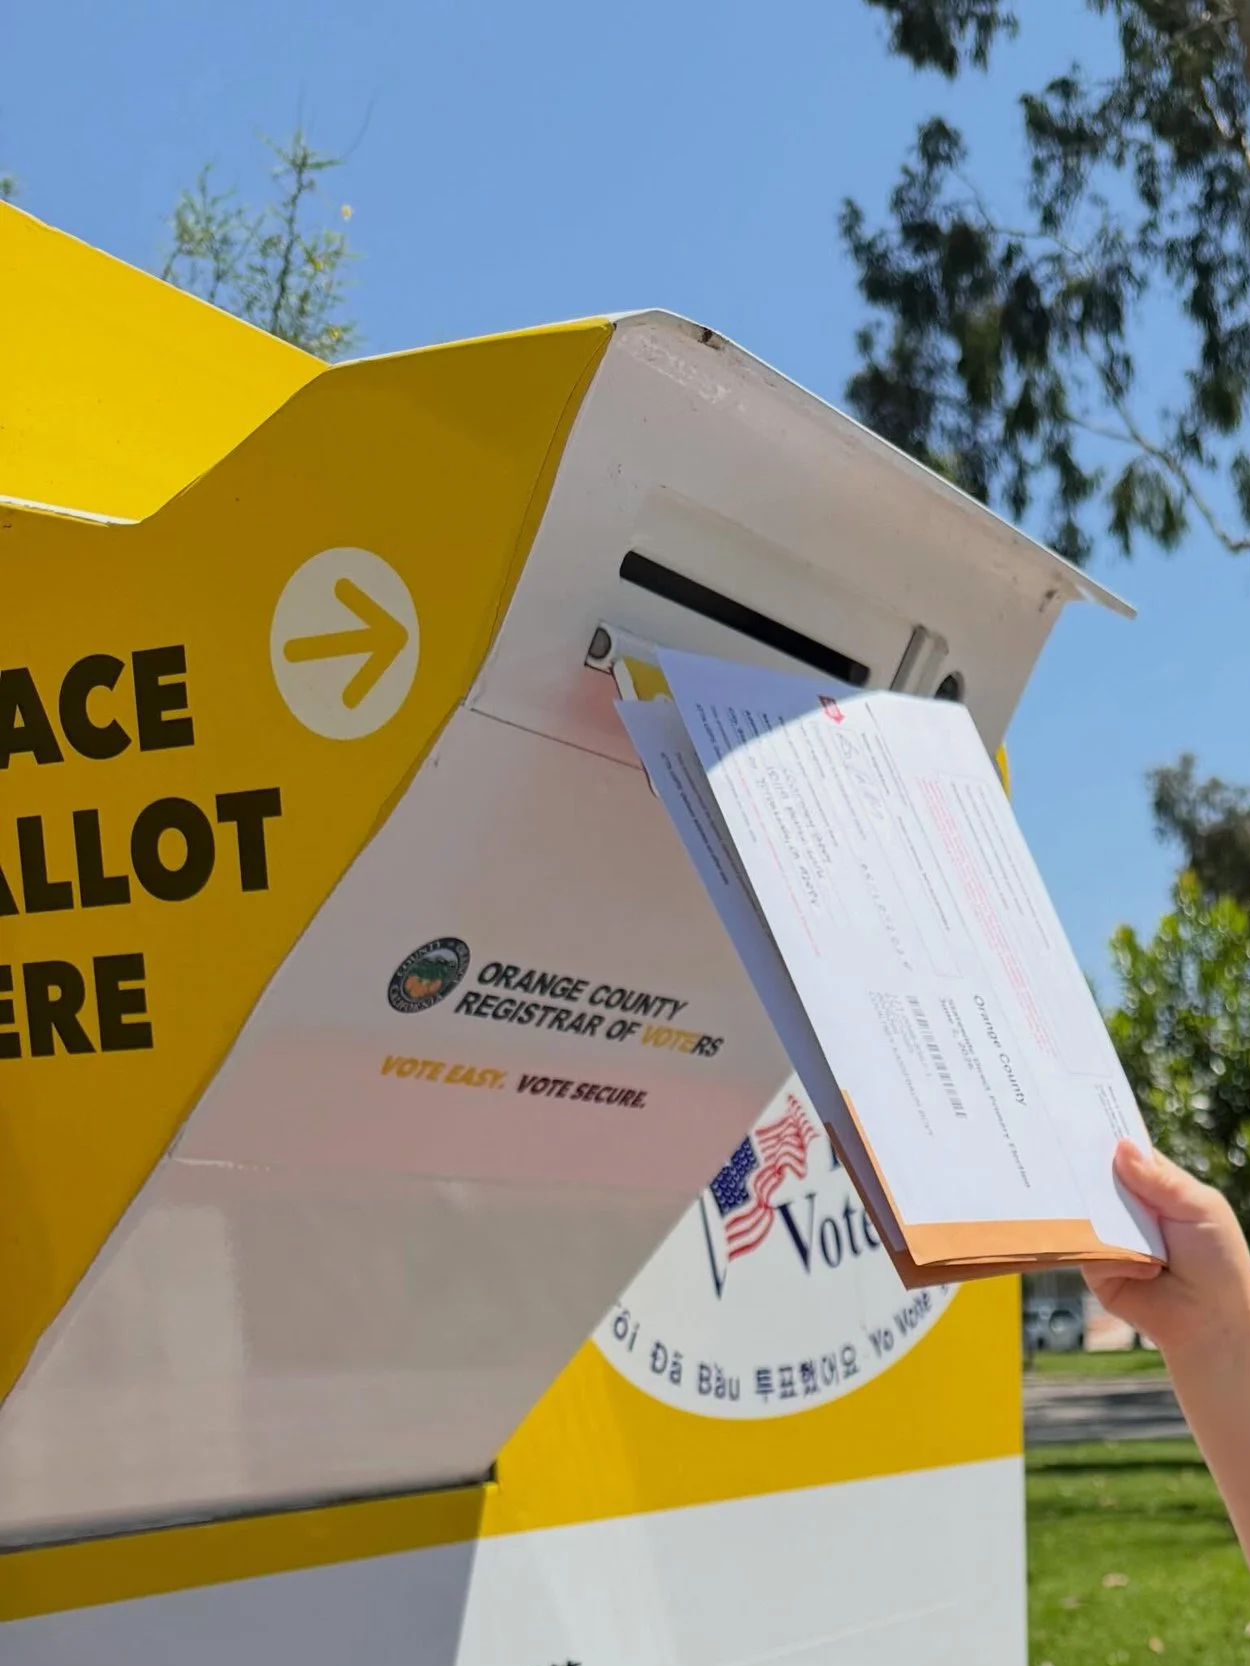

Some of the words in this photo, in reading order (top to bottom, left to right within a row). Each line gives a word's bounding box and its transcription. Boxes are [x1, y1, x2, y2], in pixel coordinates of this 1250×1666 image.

[454, 991, 605, 1039] REGISTRAR
[605, 1019, 642, 1043] OF
[640, 1025, 725, 1058] VOTERS
[477, 962, 588, 1003] ORANGE
[587, 985, 689, 1022] COUNTY
[379, 1055, 443, 1083] VOTE
[444, 1065, 506, 1090] EASY.
[516, 1073, 574, 1099] VOTE
[570, 1082, 647, 1109] SECURE.
[972, 994, 1002, 1049] Orange
[997, 1052, 1027, 1106] County
[774, 1192, 882, 1276] Vote
[611, 1308, 642, 1353] ôi
[649, 1341, 685, 1386] Đã
[754, 1344, 859, 1405] 투표했어요
